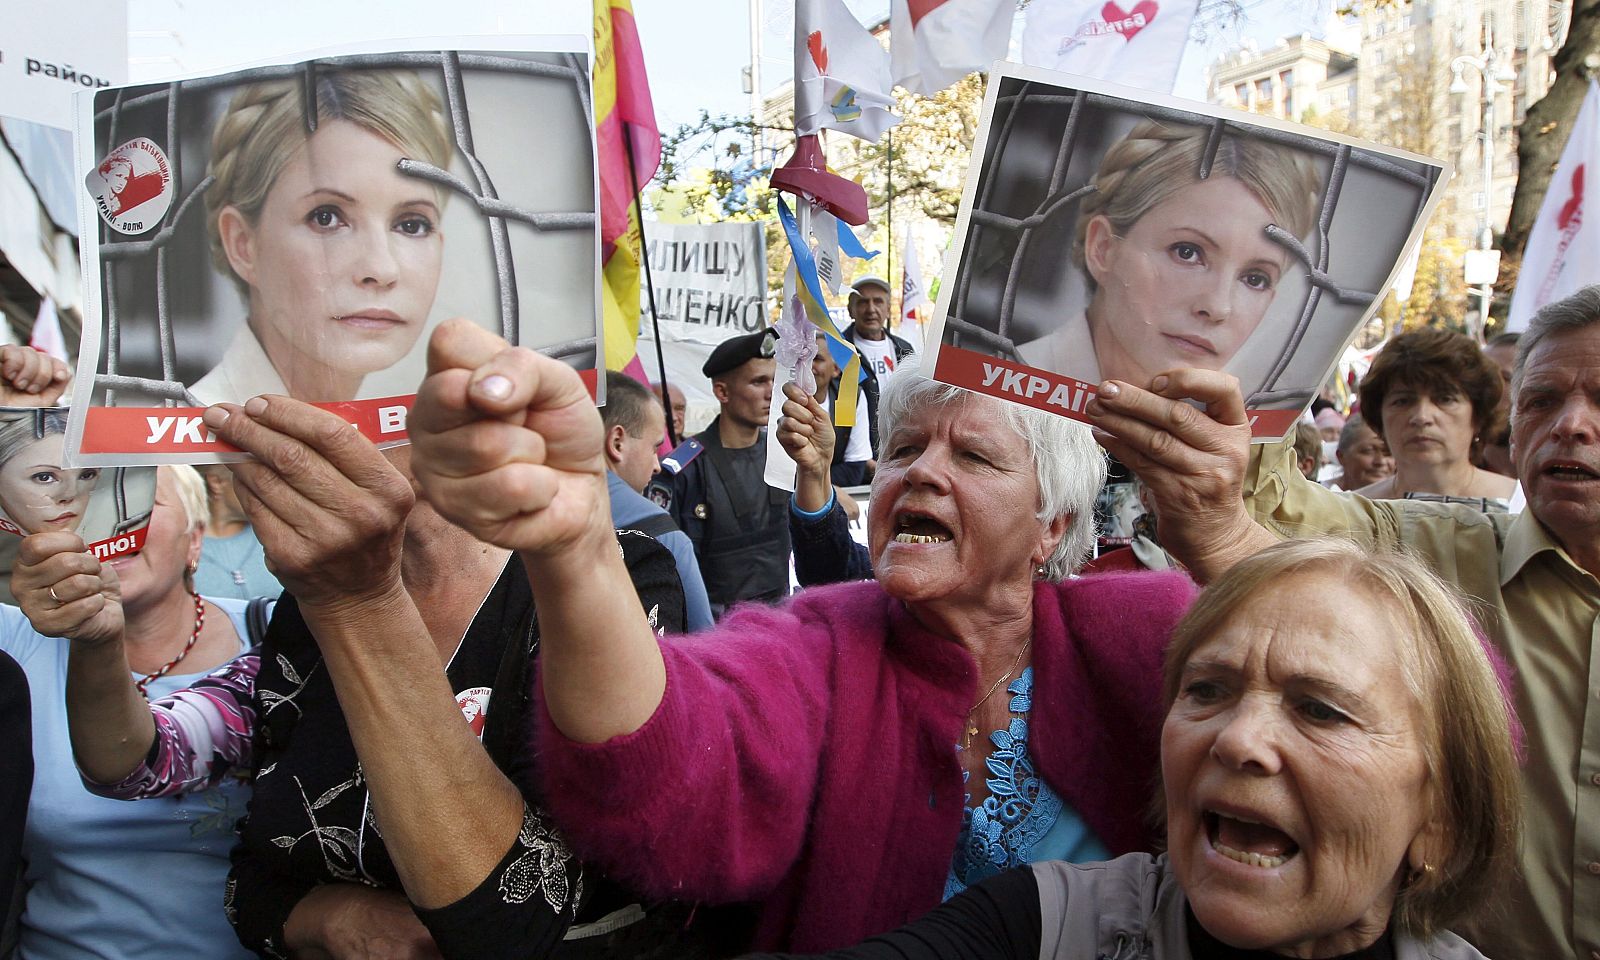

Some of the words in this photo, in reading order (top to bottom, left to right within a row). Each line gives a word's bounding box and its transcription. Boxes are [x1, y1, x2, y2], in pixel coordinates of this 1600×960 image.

[140, 142, 170, 183] БАТЬКІВЩИНА
[96, 195, 117, 224] УКРАЇНІ
[122, 221, 143, 231] ВОЛЮ
[86, 535, 137, 559] ЛЮ!
